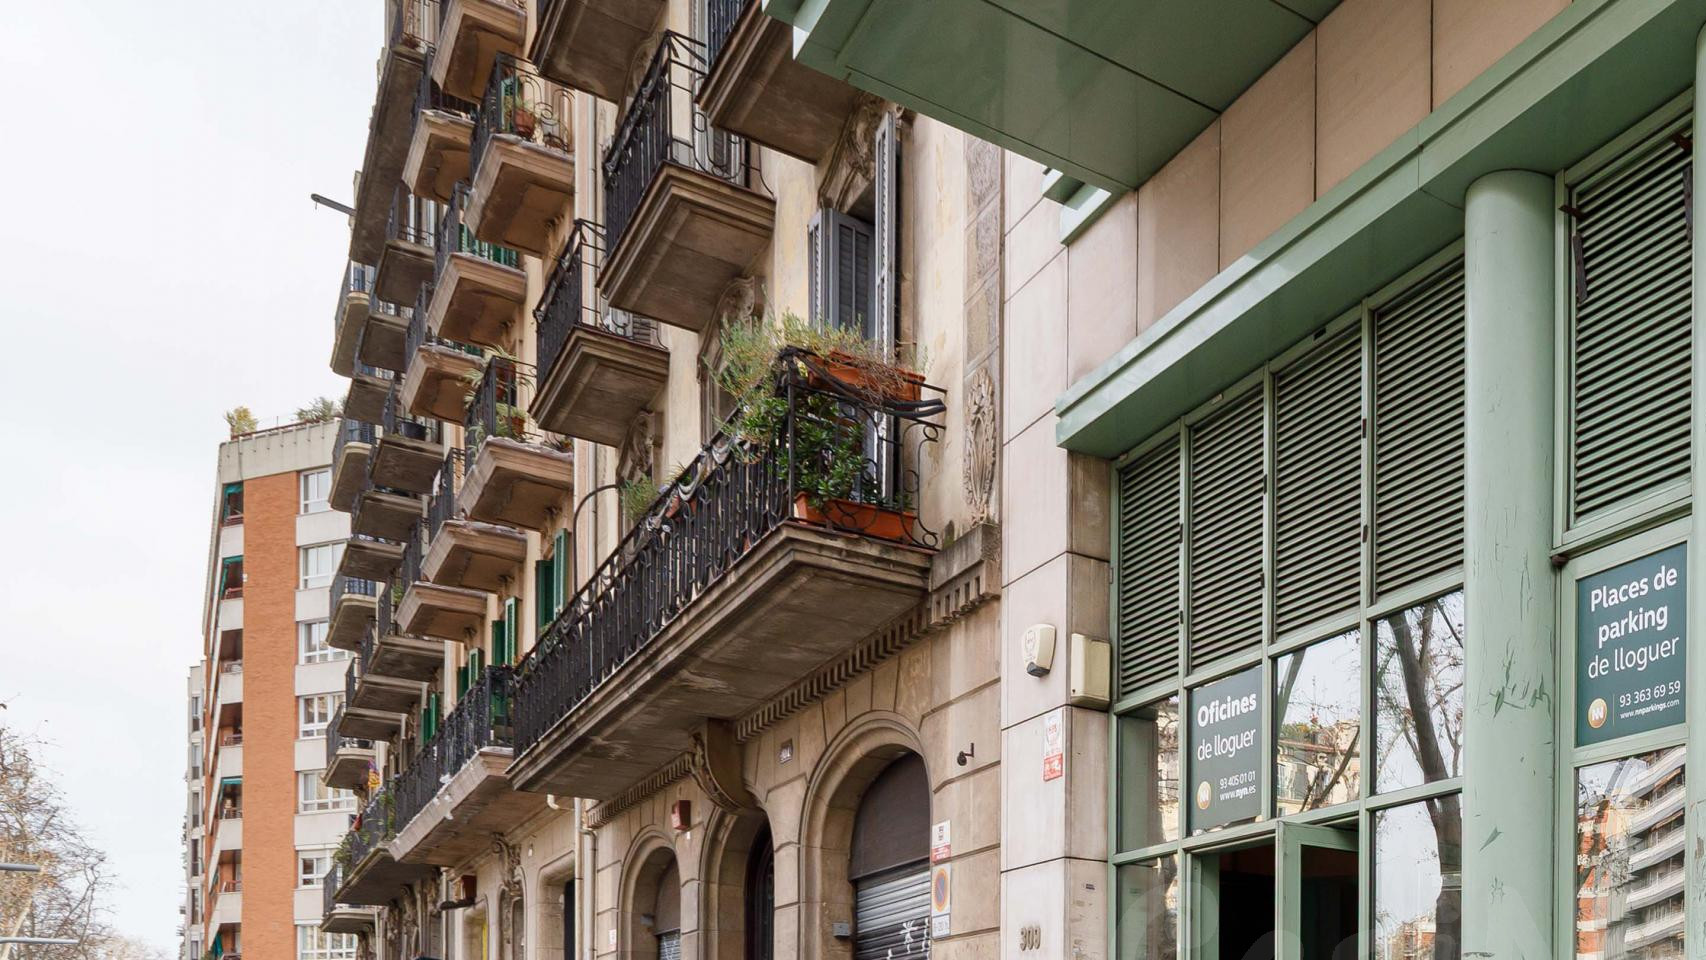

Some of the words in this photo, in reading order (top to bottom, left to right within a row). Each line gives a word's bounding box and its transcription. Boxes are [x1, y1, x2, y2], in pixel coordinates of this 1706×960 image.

[1591, 577, 1648, 612] Places
[1653, 565, 1678, 590] de
[1598, 605, 1668, 648] parking
[1588, 655, 1609, 678] de
[1614, 637, 1679, 671] lloguer
[1197, 693, 1257, 727] Oficines
[1619, 694, 1631, 707] 93
[1633, 688, 1651, 704] 363
[1653, 684, 1666, 699] 69
[1668, 680, 1681, 694] 59
[1197, 739, 1212, 760] de
[1214, 729, 1256, 758] lloguer
[1220, 777, 1227, 790] 93
